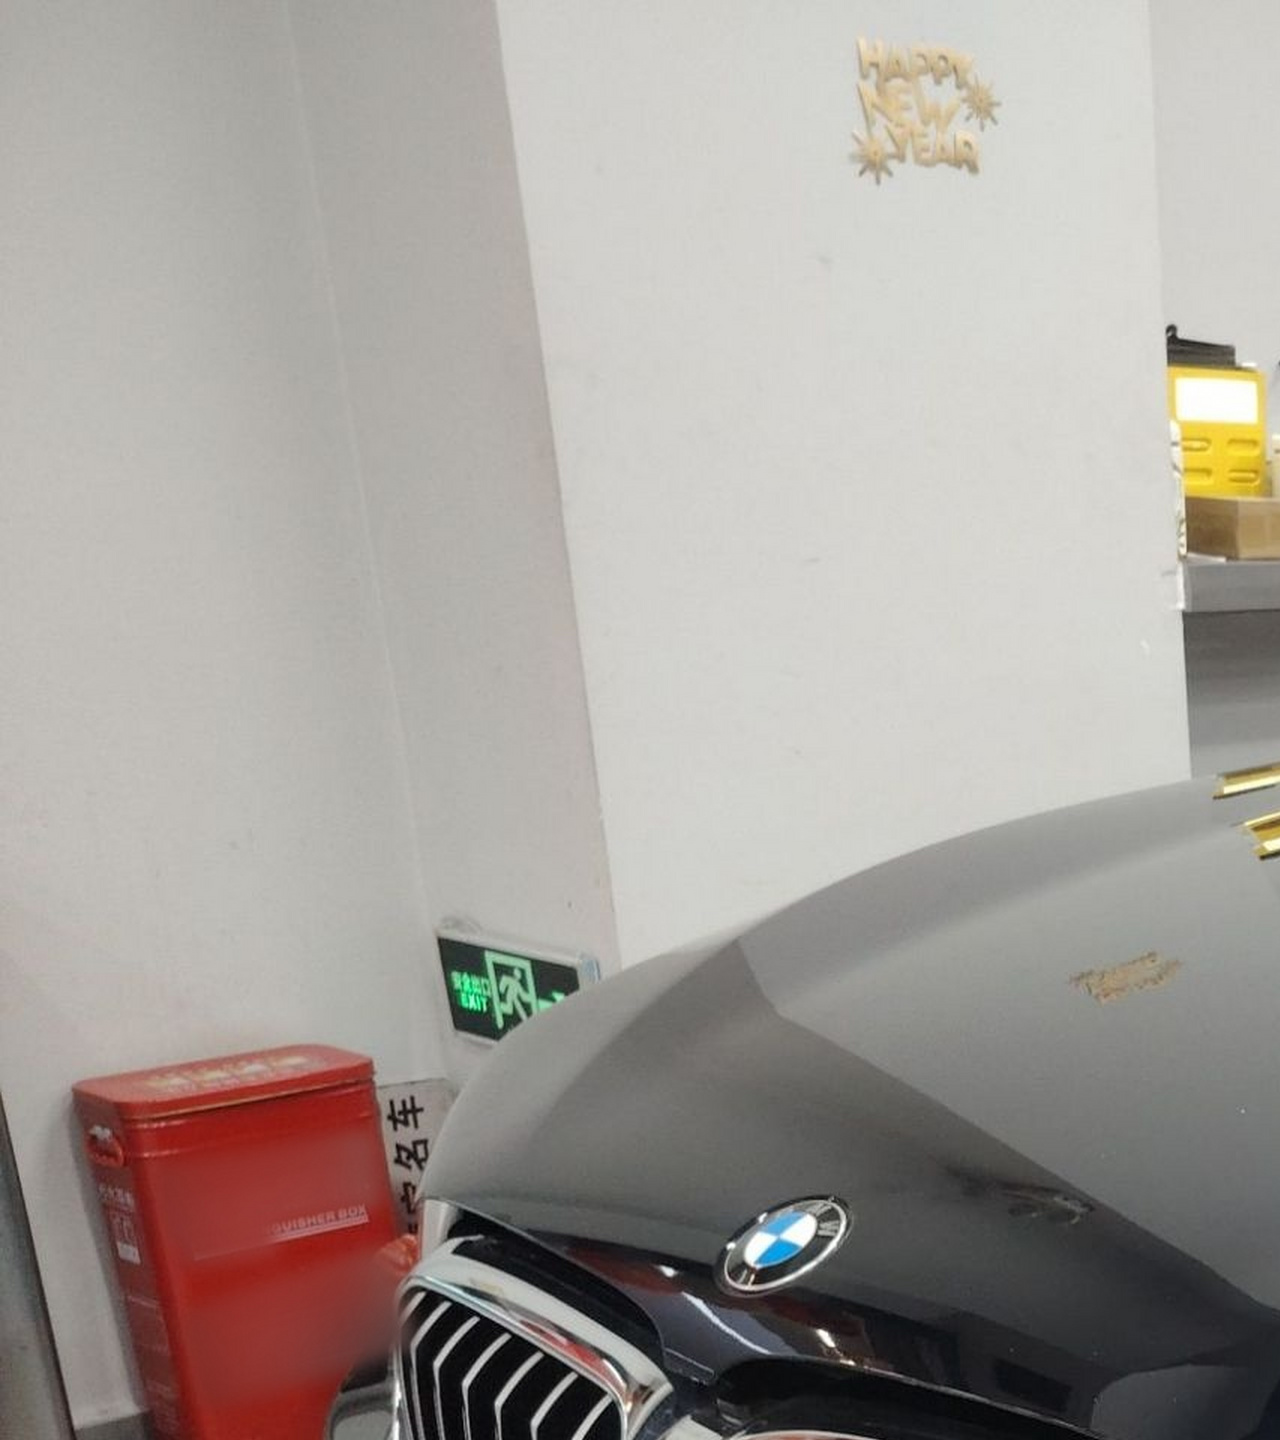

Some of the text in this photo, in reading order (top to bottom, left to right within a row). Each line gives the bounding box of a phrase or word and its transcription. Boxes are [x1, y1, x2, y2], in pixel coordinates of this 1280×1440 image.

[855, 36, 974, 91] HAPPY
[855, 79, 962, 134] NEW
[884, 120, 982, 174] YEAR
[461, 993, 488, 1013] EXIT
[337, 1203, 367, 1219] BOX
